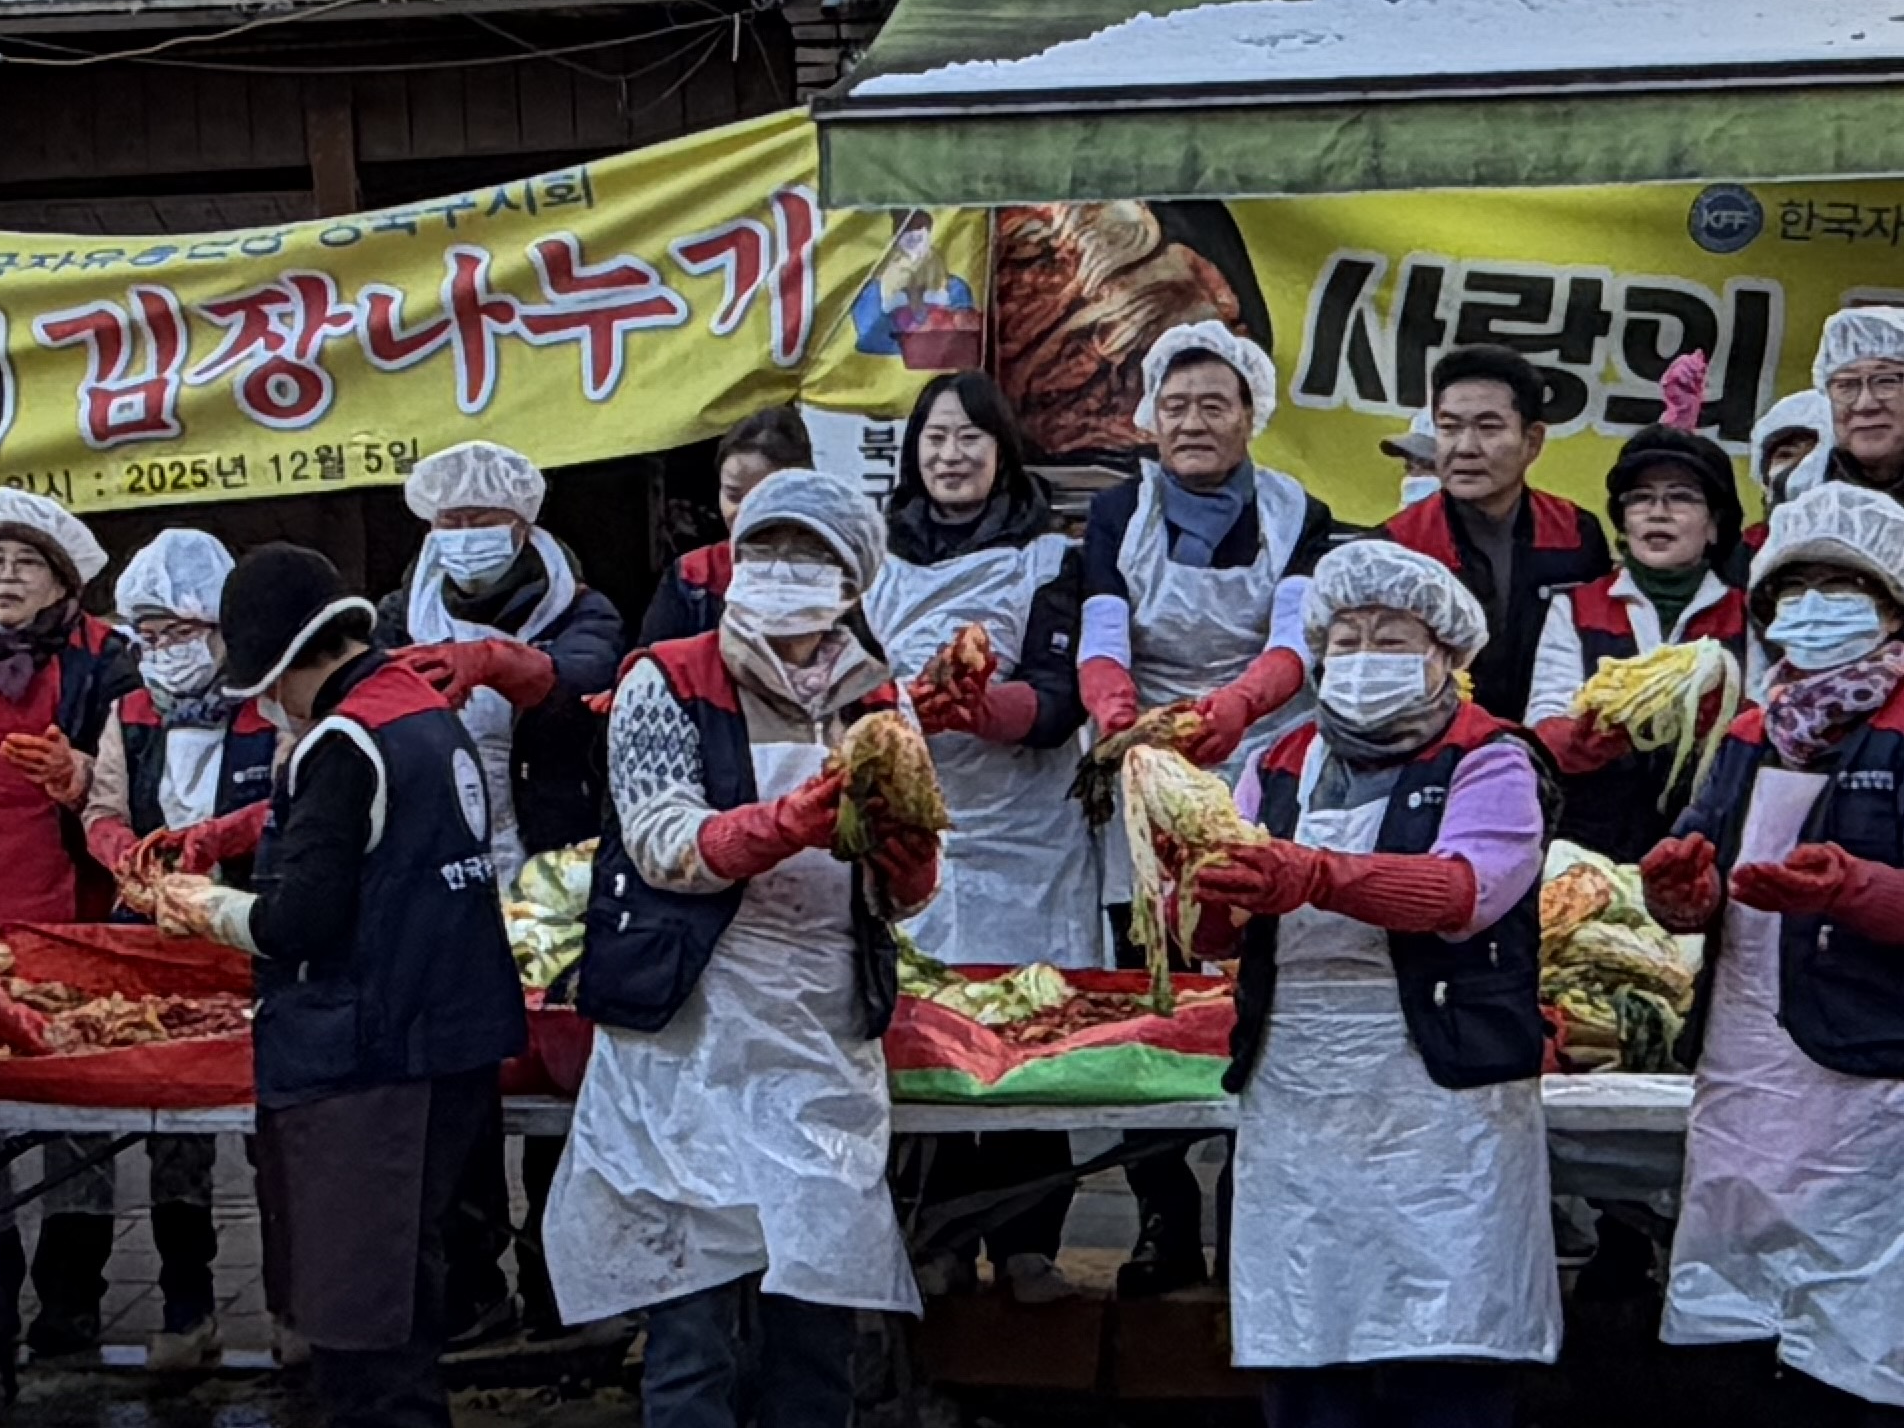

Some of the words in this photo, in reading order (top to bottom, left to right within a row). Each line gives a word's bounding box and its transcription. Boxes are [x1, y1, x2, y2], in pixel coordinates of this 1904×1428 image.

[34, 186, 819, 449] 김장나누기
[1301, 259, 1773, 443] 사랑의
[126, 454, 248, 493] 2025년
[269, 444, 346, 482] 12월
[363, 438, 420, 474] 5일
